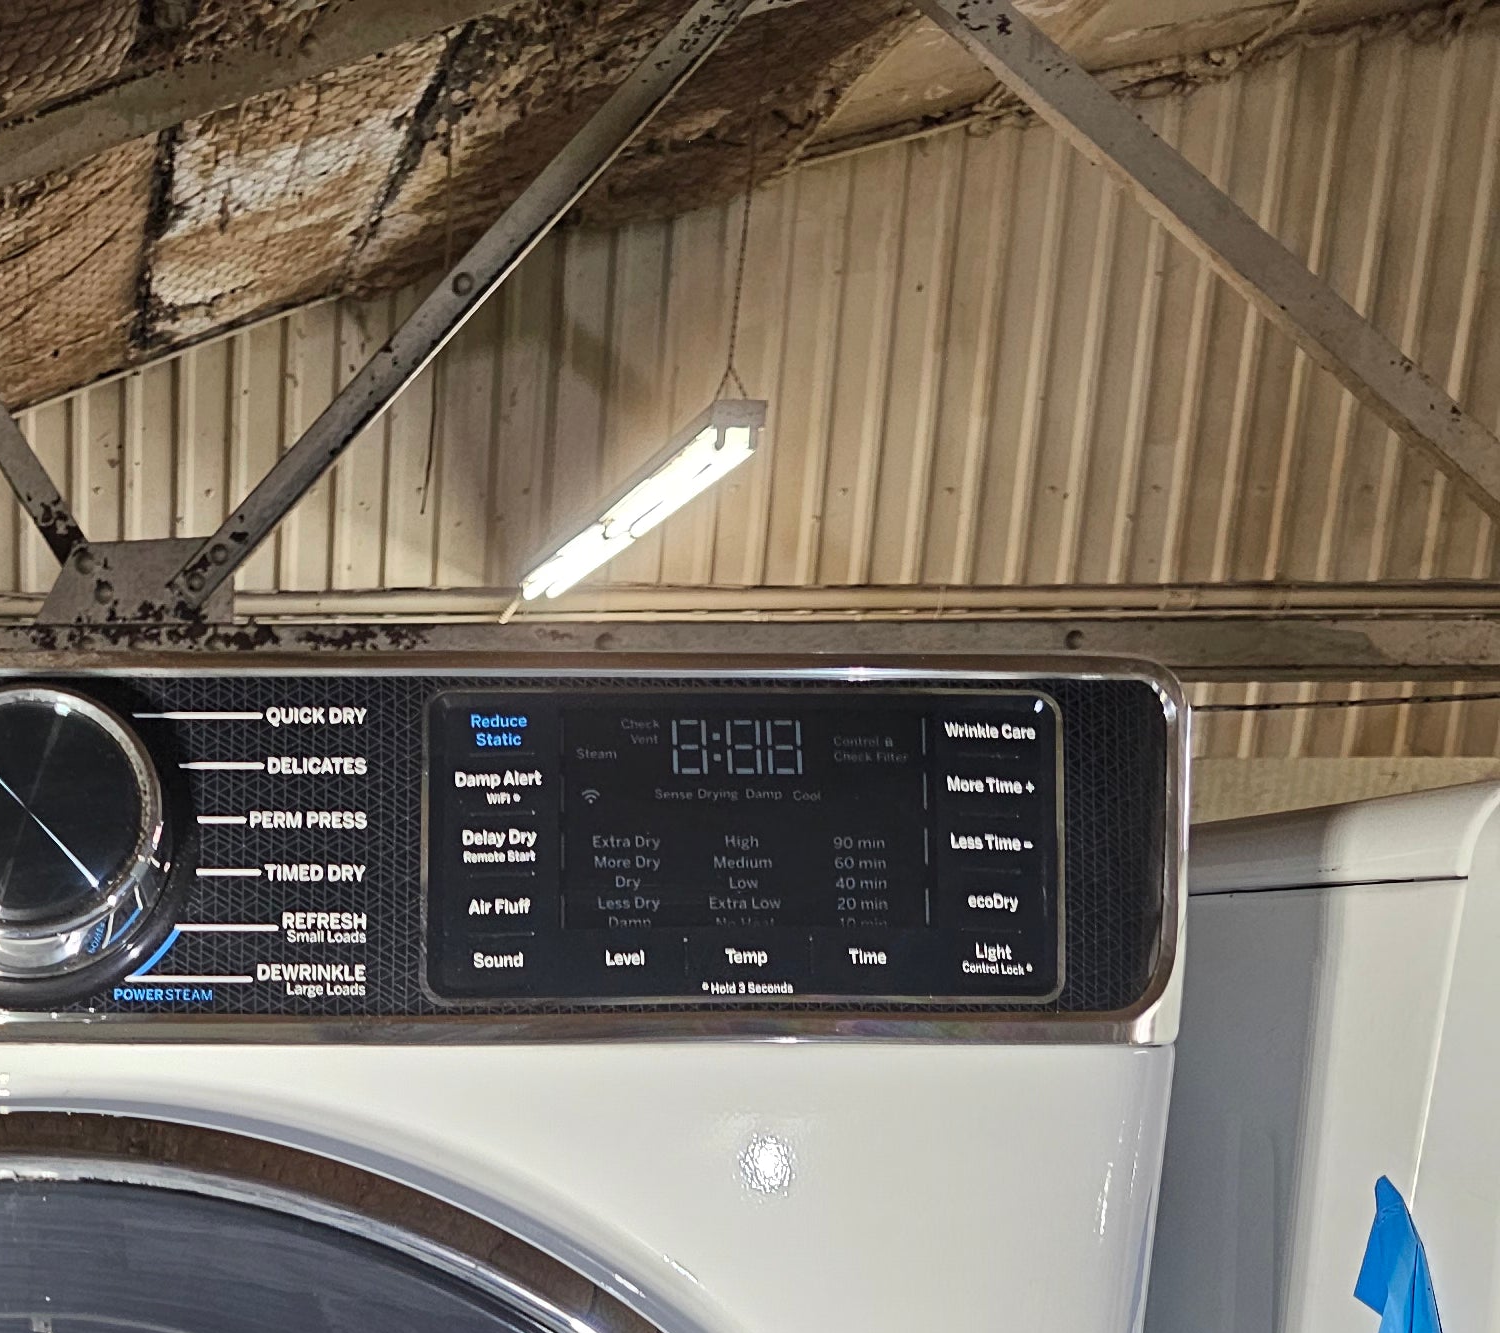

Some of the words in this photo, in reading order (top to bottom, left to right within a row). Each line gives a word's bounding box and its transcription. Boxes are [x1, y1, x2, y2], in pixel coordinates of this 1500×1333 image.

[266, 706, 325, 727] QUICK
[329, 706, 367, 725] DRY
[470, 713, 528, 729] Reduce
[944, 721, 999, 739] Wrinkle
[1001, 722, 1036, 740] Care
[476, 732, 522, 747] Static
[267, 757, 367, 775] DELICATES
[454, 770, 501, 789] Damp
[503, 769, 543, 787] Alert
[946, 775, 984, 793] More
[986, 776, 1023, 794] Time
[249, 810, 302, 829] PERM
[306, 811, 368, 829] PRESS
[462, 828, 506, 848] Delay
[509, 828, 538, 848] Dry
[592, 835, 631, 848] Extra
[635, 835, 661, 851] Dry
[725, 835, 759, 850] High
[833, 836, 854, 850] 90
[857, 836, 886, 849] min
[950, 832, 983, 850] Less
[985, 833, 1022, 851] Time
[462, 851, 506, 864] Remote
[507, 849, 536, 863] Start
[594, 855, 631, 869] More
[635, 855, 661, 871] Dry
[713, 855, 773, 869] Medium
[834, 857, 855, 870] 60
[858, 857, 887, 870] min
[264, 863, 324, 882] TIMED
[328, 864, 366, 883] DRY
[615, 876, 641, 891] Dry
[729, 876, 759, 890] Low
[835, 877, 856, 890] 40
[859, 877, 888, 890] min
[468, 898, 493, 915] Air
[494, 898, 531, 915] Fluff
[598, 897, 631, 910] Less
[635, 897, 661, 913] Dry
[709, 897, 747, 910] Extra
[751, 897, 782, 910] Low
[837, 898, 857, 911] 20
[861, 898, 889, 911] min
[967, 893, 1019, 912] ecoDry
[282, 912, 367, 930] REFRESH
[286, 930, 325, 943] Small
[327, 930, 367, 944] Loads
[605, 949, 645, 966] Level
[725, 947, 768, 967] Temp
[848, 948, 887, 965] Time
[975, 942, 1012, 961] Light
[473, 951, 524, 969] Sound
[257, 963, 366, 982] DEWRINKLE
[962, 961, 999, 975] Control
[1001, 962, 1025, 976] Lock
[286, 982, 325, 998] Large
[326, 982, 366, 997] Loads
[711, 981, 736, 995] Hold
[738, 981, 746, 994] 3
[748, 981, 794, 994] Seconds
